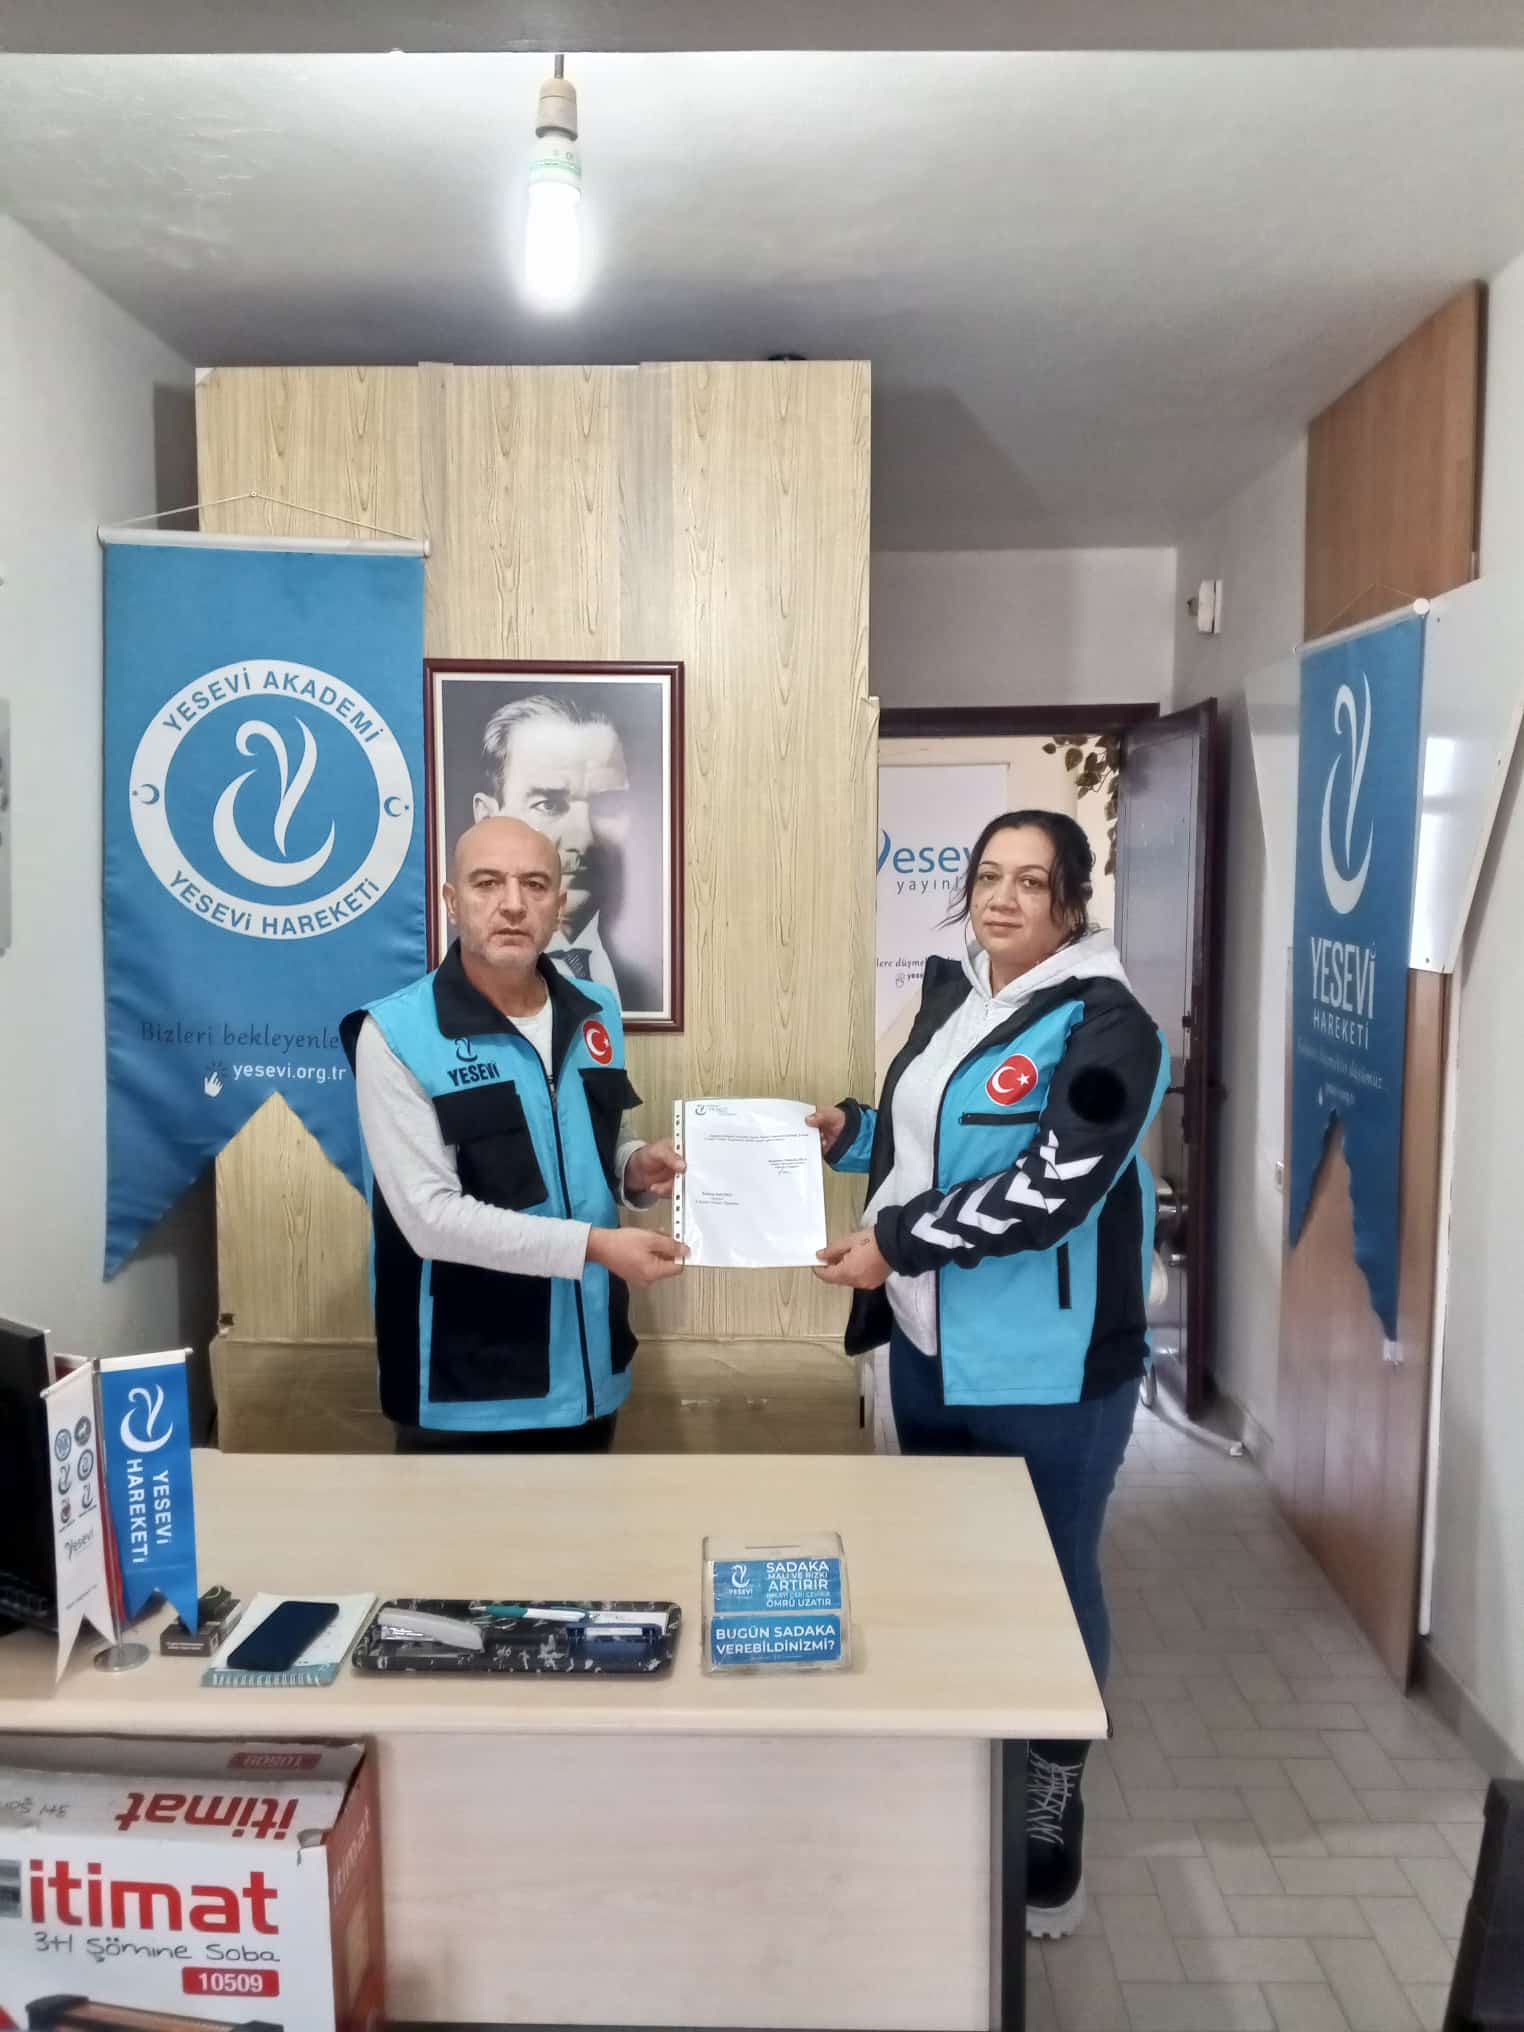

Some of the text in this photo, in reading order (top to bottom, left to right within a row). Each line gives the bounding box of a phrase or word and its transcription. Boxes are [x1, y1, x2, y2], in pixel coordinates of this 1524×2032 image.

[163, 667, 385, 744] YESEVİ AKADEMİ
[169, 870, 381, 937] YESEVİ HAREKETİ
[1311, 936, 1376, 1020] YESEVİ
[141, 1020, 212, 1045] Bizleri
[1313, 1007, 1369, 1051] HAREKETİ
[233, 1062, 347, 1085] yesevi.org.tr
[766, 1561, 829, 1573] SADAKA
[768, 1579, 829, 1592] ARTIRIR
[798, 1598, 832, 1608] UZATIR
[716, 1625, 836, 1640] BUGÜN SADAKA
[716, 1637, 836, 1655] VEREBİLDİNİZMİ?
[115, 1792, 299, 1840] itimat
[30, 1859, 279, 1935] itimat
[206, 1943, 280, 1963] Soba
[198, 1972, 264, 1994] 10509
